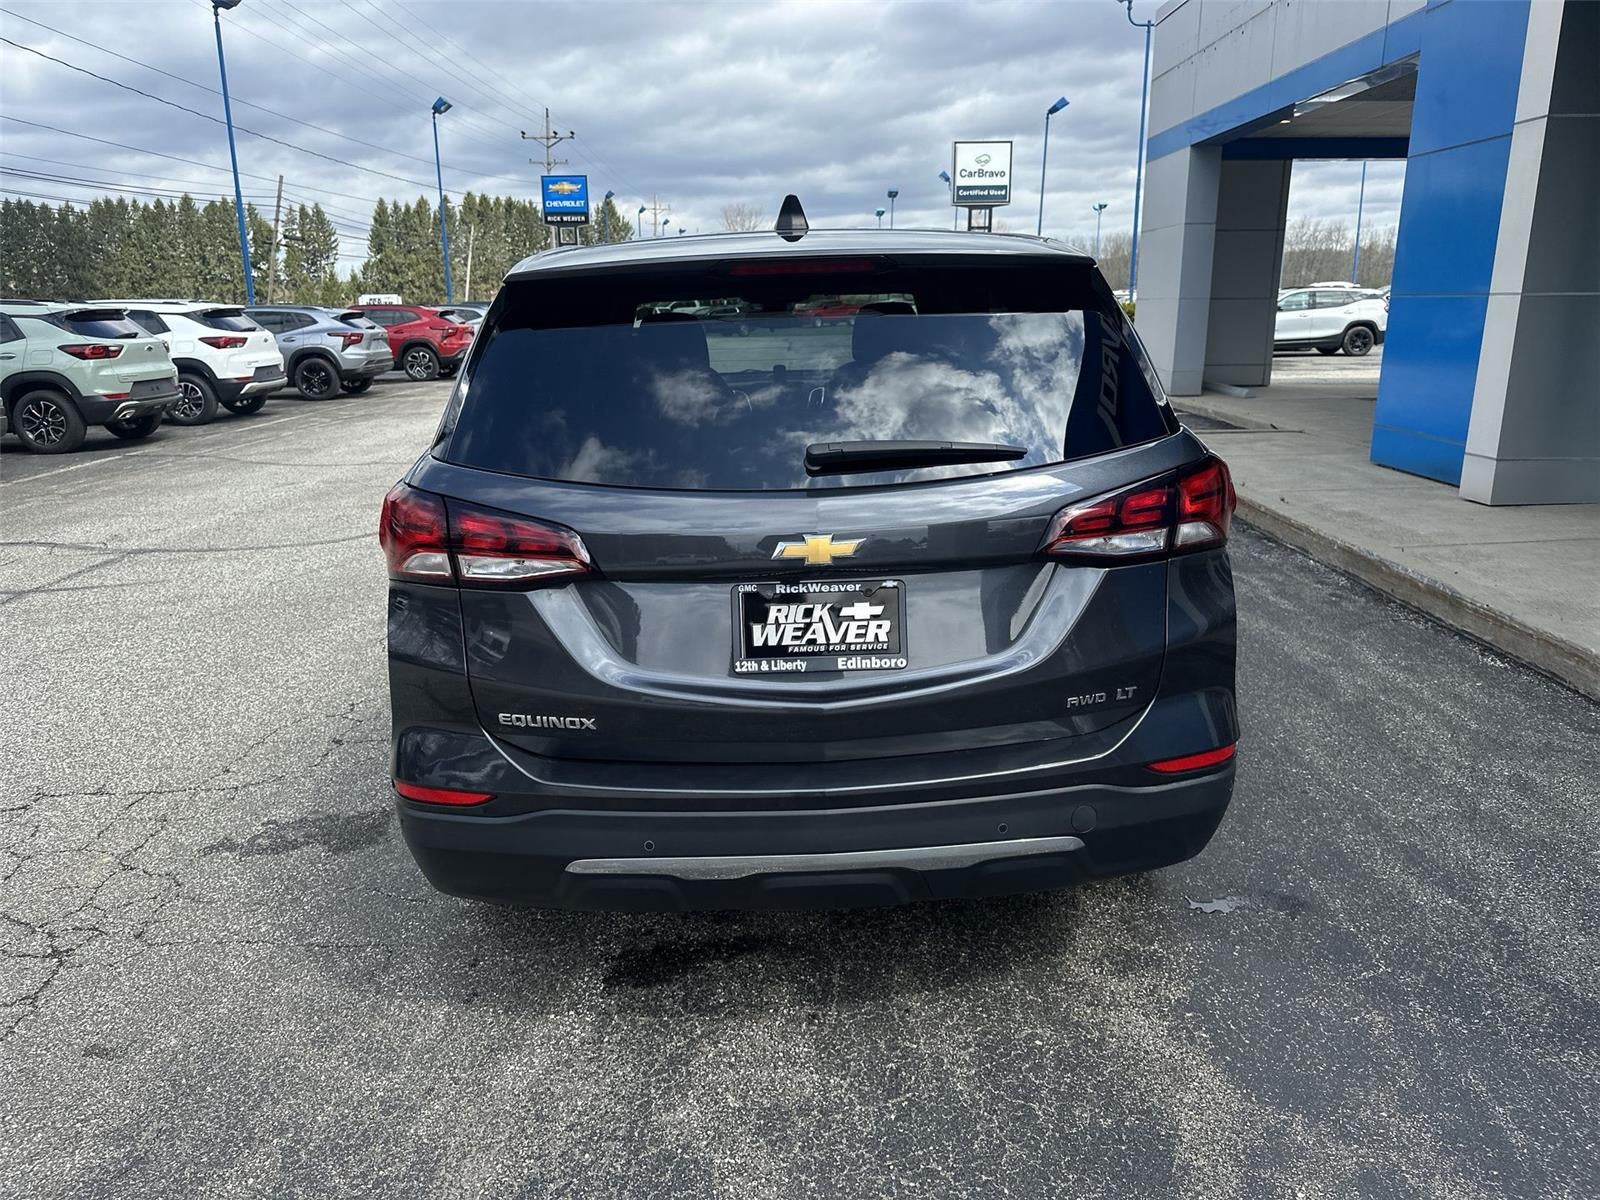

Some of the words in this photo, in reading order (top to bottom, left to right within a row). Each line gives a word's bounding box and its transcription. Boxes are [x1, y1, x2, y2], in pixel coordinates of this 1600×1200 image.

[959, 168, 1006, 178] CarBravo
[545, 200, 585, 208] CHEVROLET
[738, 584, 757, 592] GMC
[775, 583, 862, 594] RickWeaver
[766, 602, 833, 624] RICK
[752, 619, 891, 647] WEAVER
[788, 645, 825, 653] FAMOUS
[850, 643, 888, 651] SERVICE
[735, 660, 758, 672] 12th
[760, 660, 769, 671] &
[771, 659, 807, 672] Liberty
[837, 656, 907, 670] Edinboro
[1066, 692, 1107, 709] AWD
[1116, 686, 1137, 701] LT
[498, 713, 597, 730] EQUINOX
